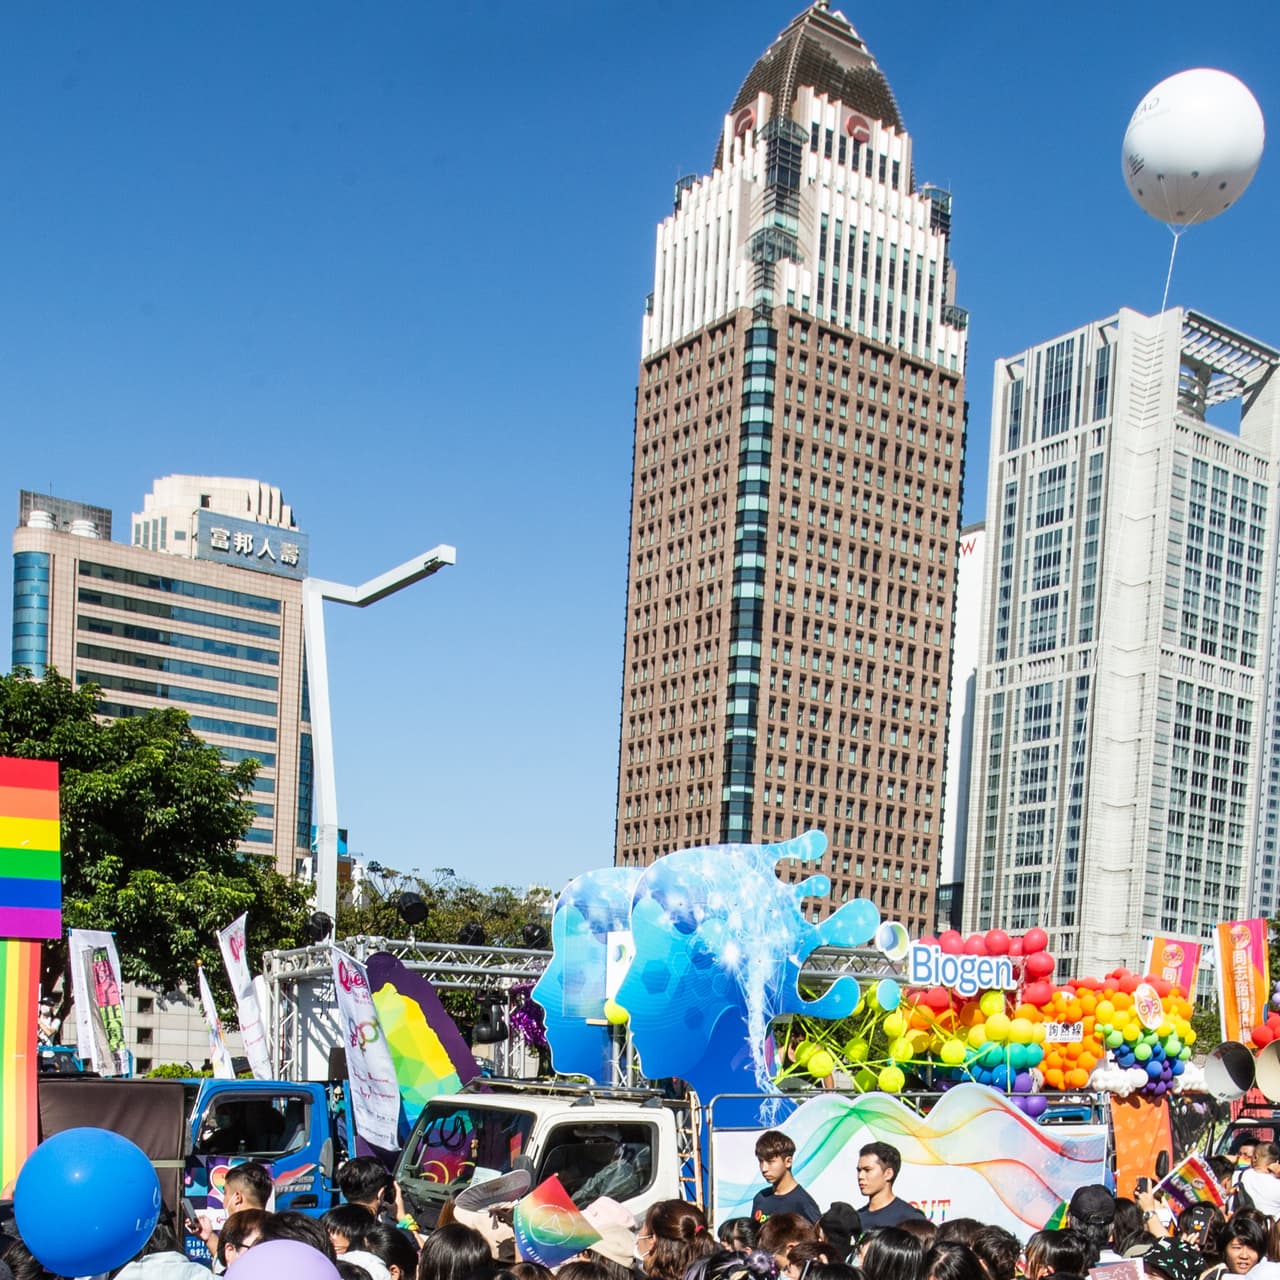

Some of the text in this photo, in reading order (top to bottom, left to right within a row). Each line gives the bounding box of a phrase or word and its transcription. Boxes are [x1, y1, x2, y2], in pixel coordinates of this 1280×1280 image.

[211, 527, 299, 565] 富邦人壽
[912, 946, 1012, 994] Biogen
